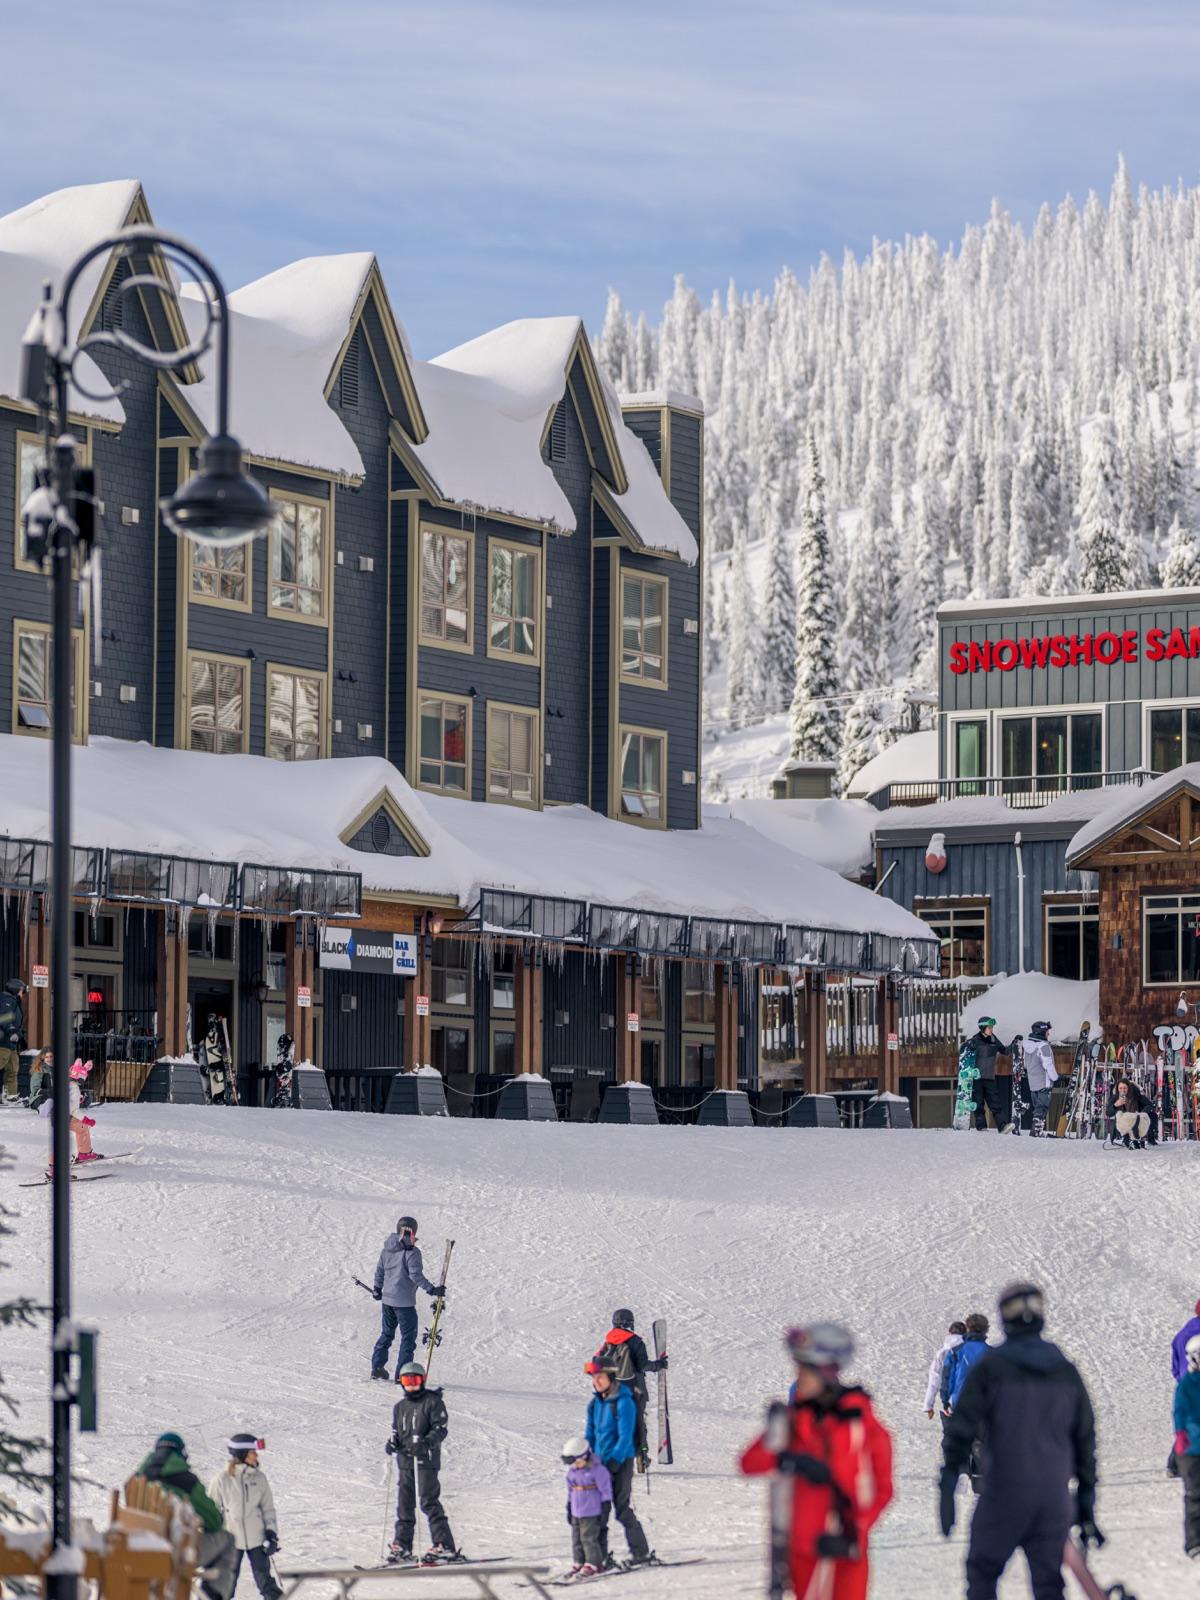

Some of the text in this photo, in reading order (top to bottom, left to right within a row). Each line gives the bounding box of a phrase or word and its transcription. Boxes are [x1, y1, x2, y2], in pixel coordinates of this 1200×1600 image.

[950, 631, 1137, 674] SNOWSHOE
[321, 941, 394, 959] BLACK DIAMOND
[394, 940, 409, 951] BAR
[396, 957, 416, 969] GRILL
